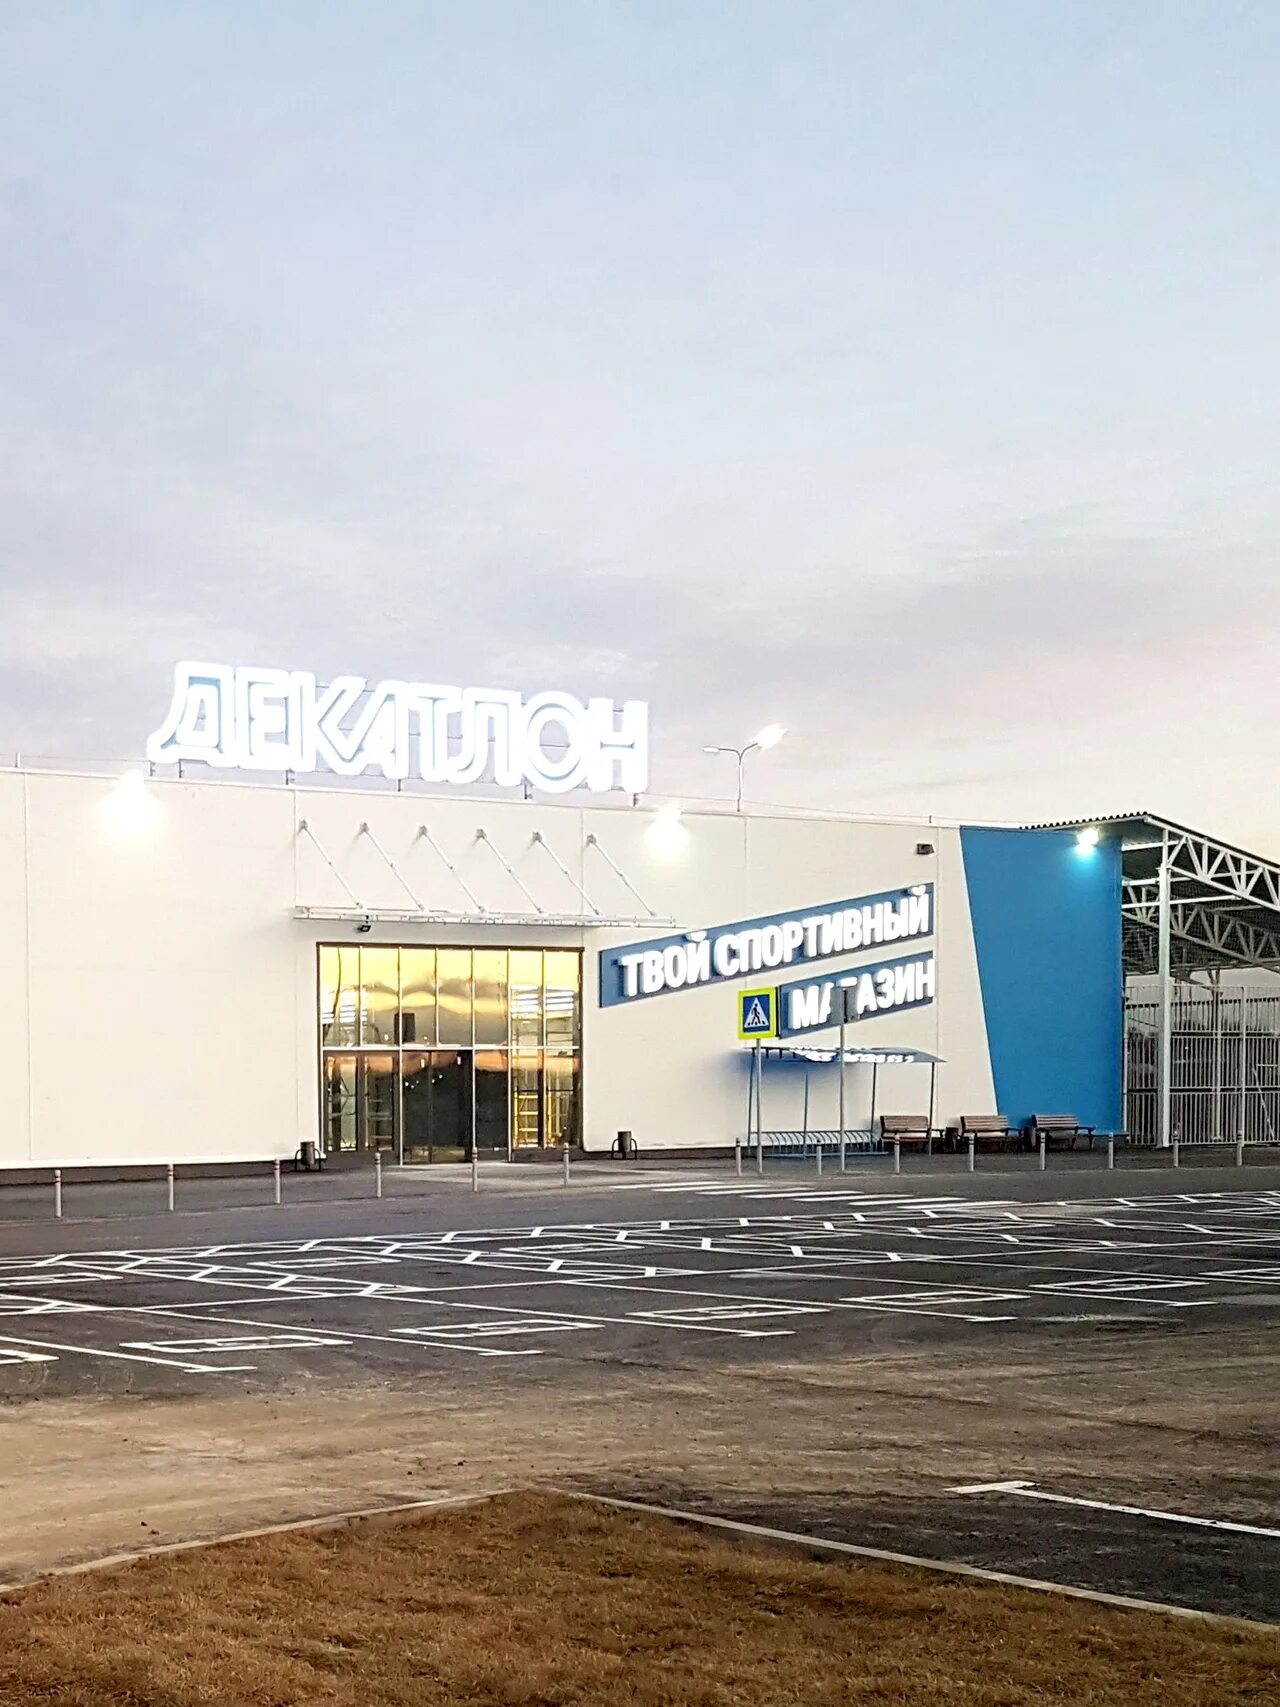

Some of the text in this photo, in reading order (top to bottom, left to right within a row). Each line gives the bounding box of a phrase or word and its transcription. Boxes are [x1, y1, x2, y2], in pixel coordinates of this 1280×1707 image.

[147, 661, 649, 793] ДЕКАТЛОН
[620, 885, 930, 997] ТВОЙ СПОРТИВНЫЙ
